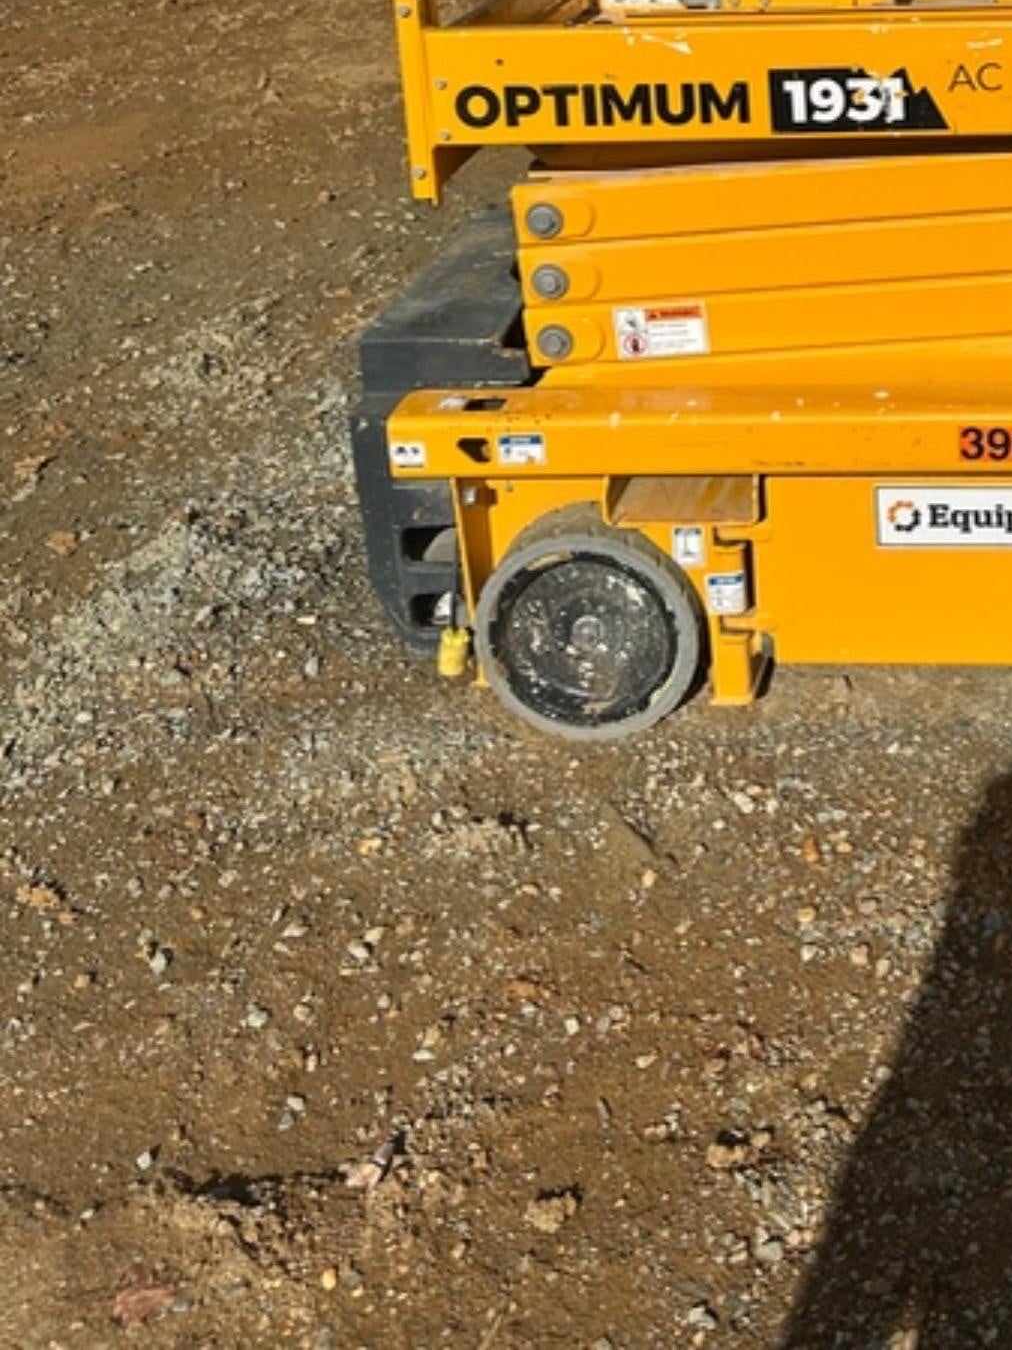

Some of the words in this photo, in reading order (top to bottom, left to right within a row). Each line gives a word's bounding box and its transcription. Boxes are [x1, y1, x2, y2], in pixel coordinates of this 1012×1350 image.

[455, 81, 751, 129] OPTIMUM
[781, 77, 906, 124] 1931
[947, 62, 1003, 92] AC
